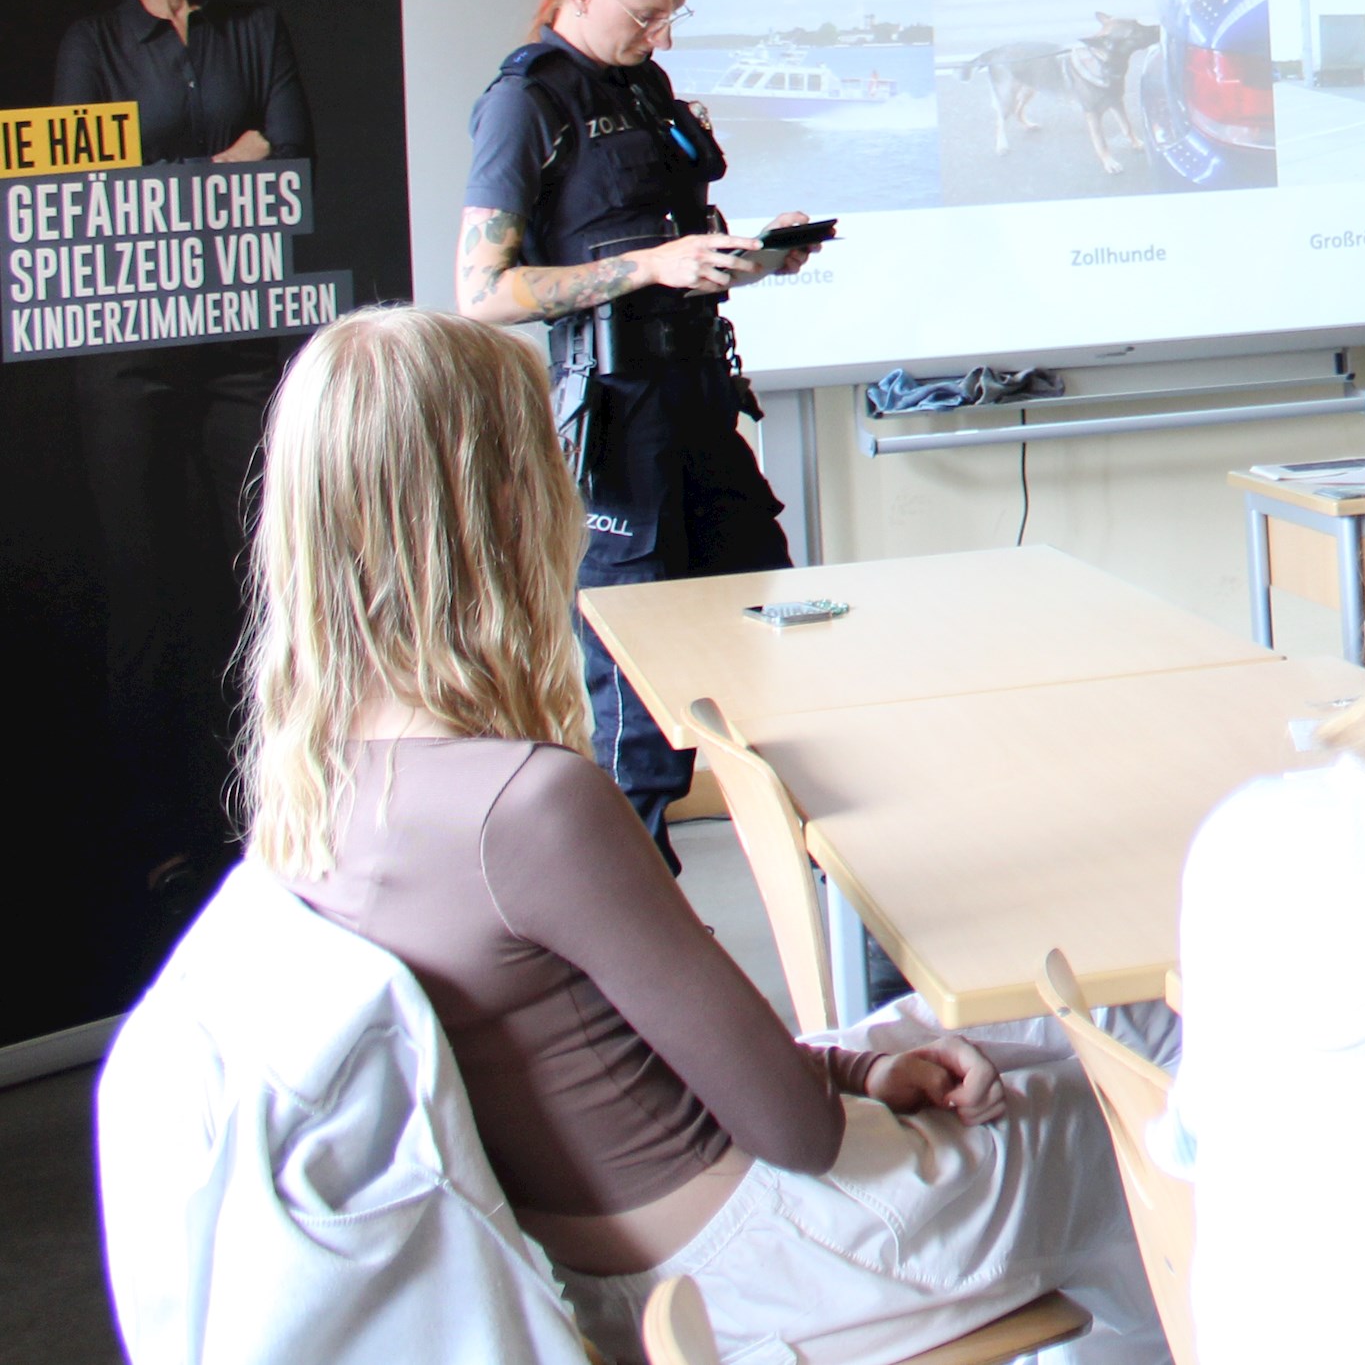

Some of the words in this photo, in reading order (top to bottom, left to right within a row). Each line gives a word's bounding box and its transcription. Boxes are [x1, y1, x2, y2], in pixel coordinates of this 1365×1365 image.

[1, 121, 35, 170] IE
[49, 109, 129, 166] HÄLT
[8, 171, 301, 243] GEFÄHRLICHES
[10, 237, 204, 303] SPIELZEUG
[214, 232, 283, 286] VON
[1070, 245, 1167, 266] Zollhunde
[12, 289, 259, 354] KINDERZIMMERN
[585, 513, 633, 537] ZOLL
